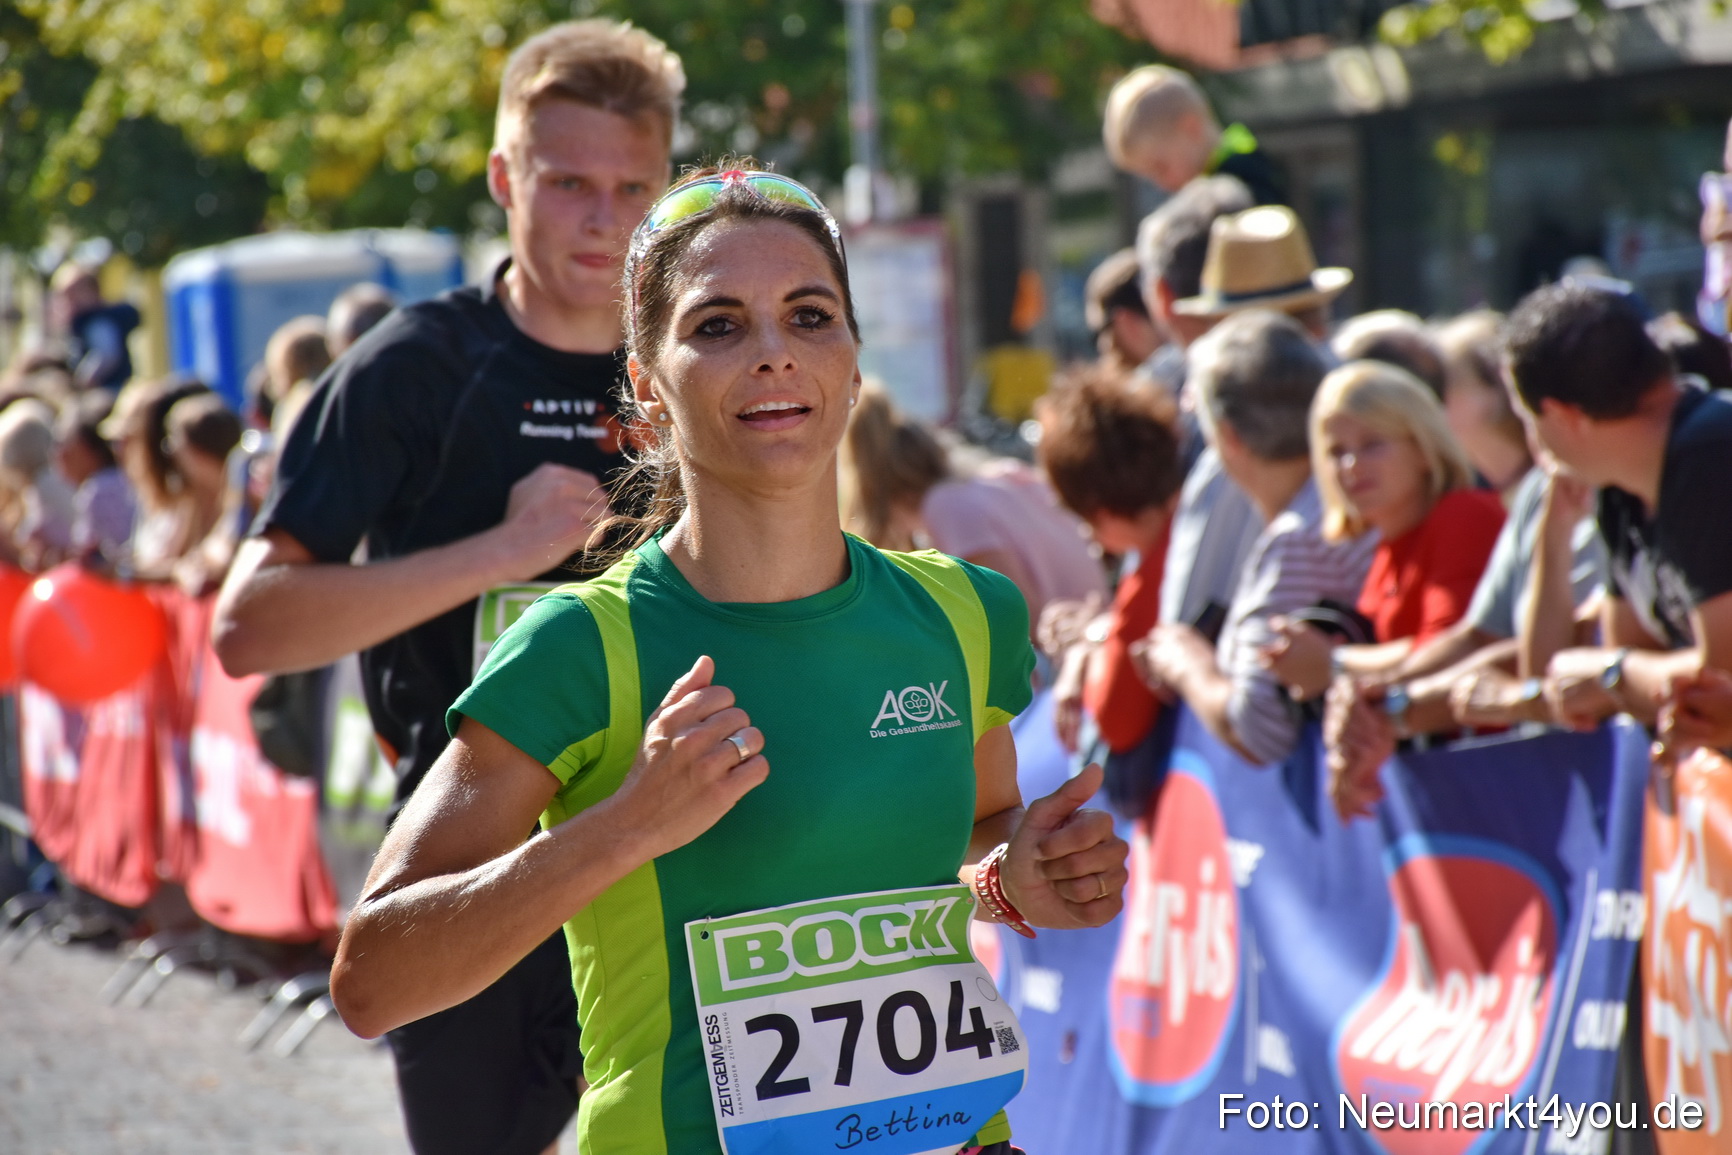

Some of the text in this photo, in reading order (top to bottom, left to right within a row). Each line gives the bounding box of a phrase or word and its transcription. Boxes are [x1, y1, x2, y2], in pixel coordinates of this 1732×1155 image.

[519, 421, 608, 441] Running Team
[871, 680, 957, 729] AOK
[869, 729, 887, 738] Die
[716, 898, 959, 989] BOCK
[722, 1011, 744, 1115] TRANSPONDER ZEITMESSUNG
[745, 980, 995, 1101] 2704
[835, 1103, 972, 1150] Bettina
